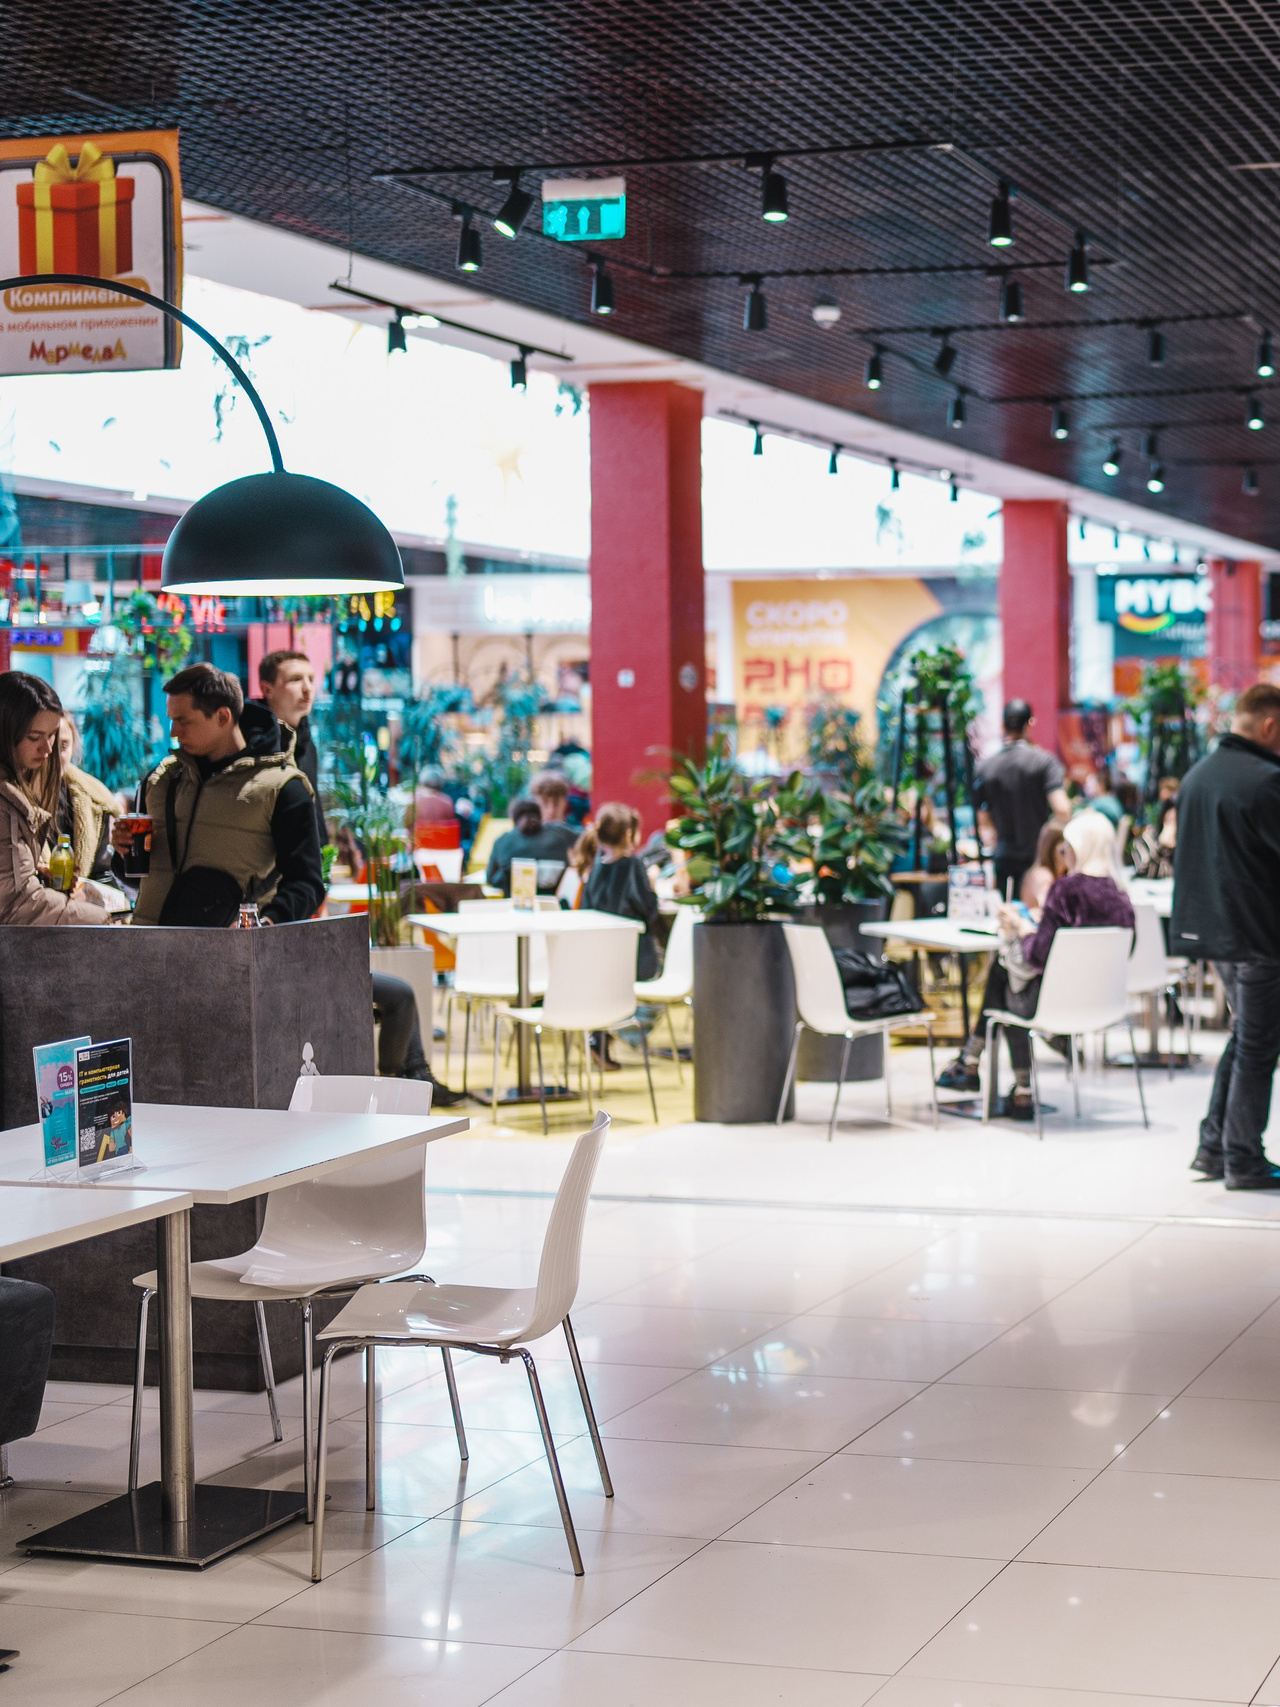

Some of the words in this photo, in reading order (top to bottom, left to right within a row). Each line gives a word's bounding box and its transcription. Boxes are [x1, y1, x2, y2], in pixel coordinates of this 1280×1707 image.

[7, 318, 78, 333] мобильном
[80, 316, 159, 331] приложении
[116, 1068, 129, 1077] детей
